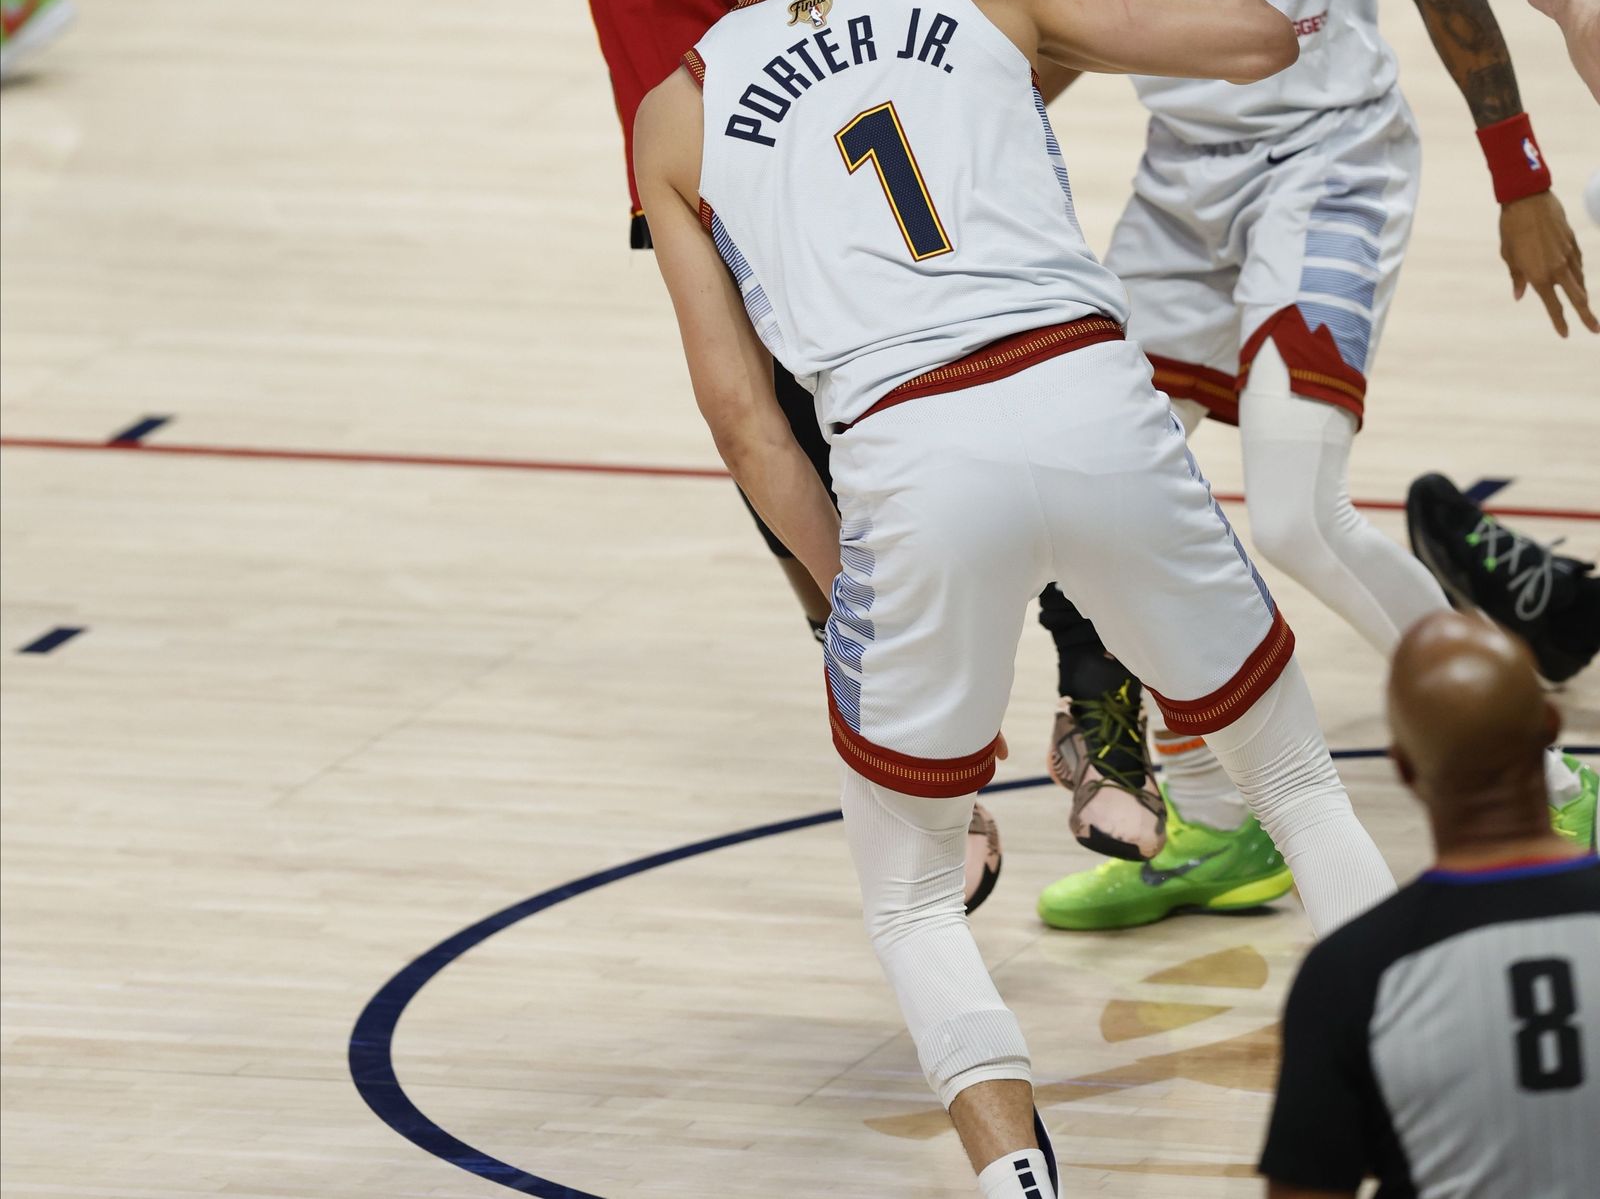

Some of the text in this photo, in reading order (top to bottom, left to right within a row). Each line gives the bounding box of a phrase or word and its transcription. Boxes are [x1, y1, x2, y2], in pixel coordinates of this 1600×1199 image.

[724, 7, 959, 148] PORTER JR.
[833, 99, 955, 263] 1
[1506, 956, 1585, 1093] 8
